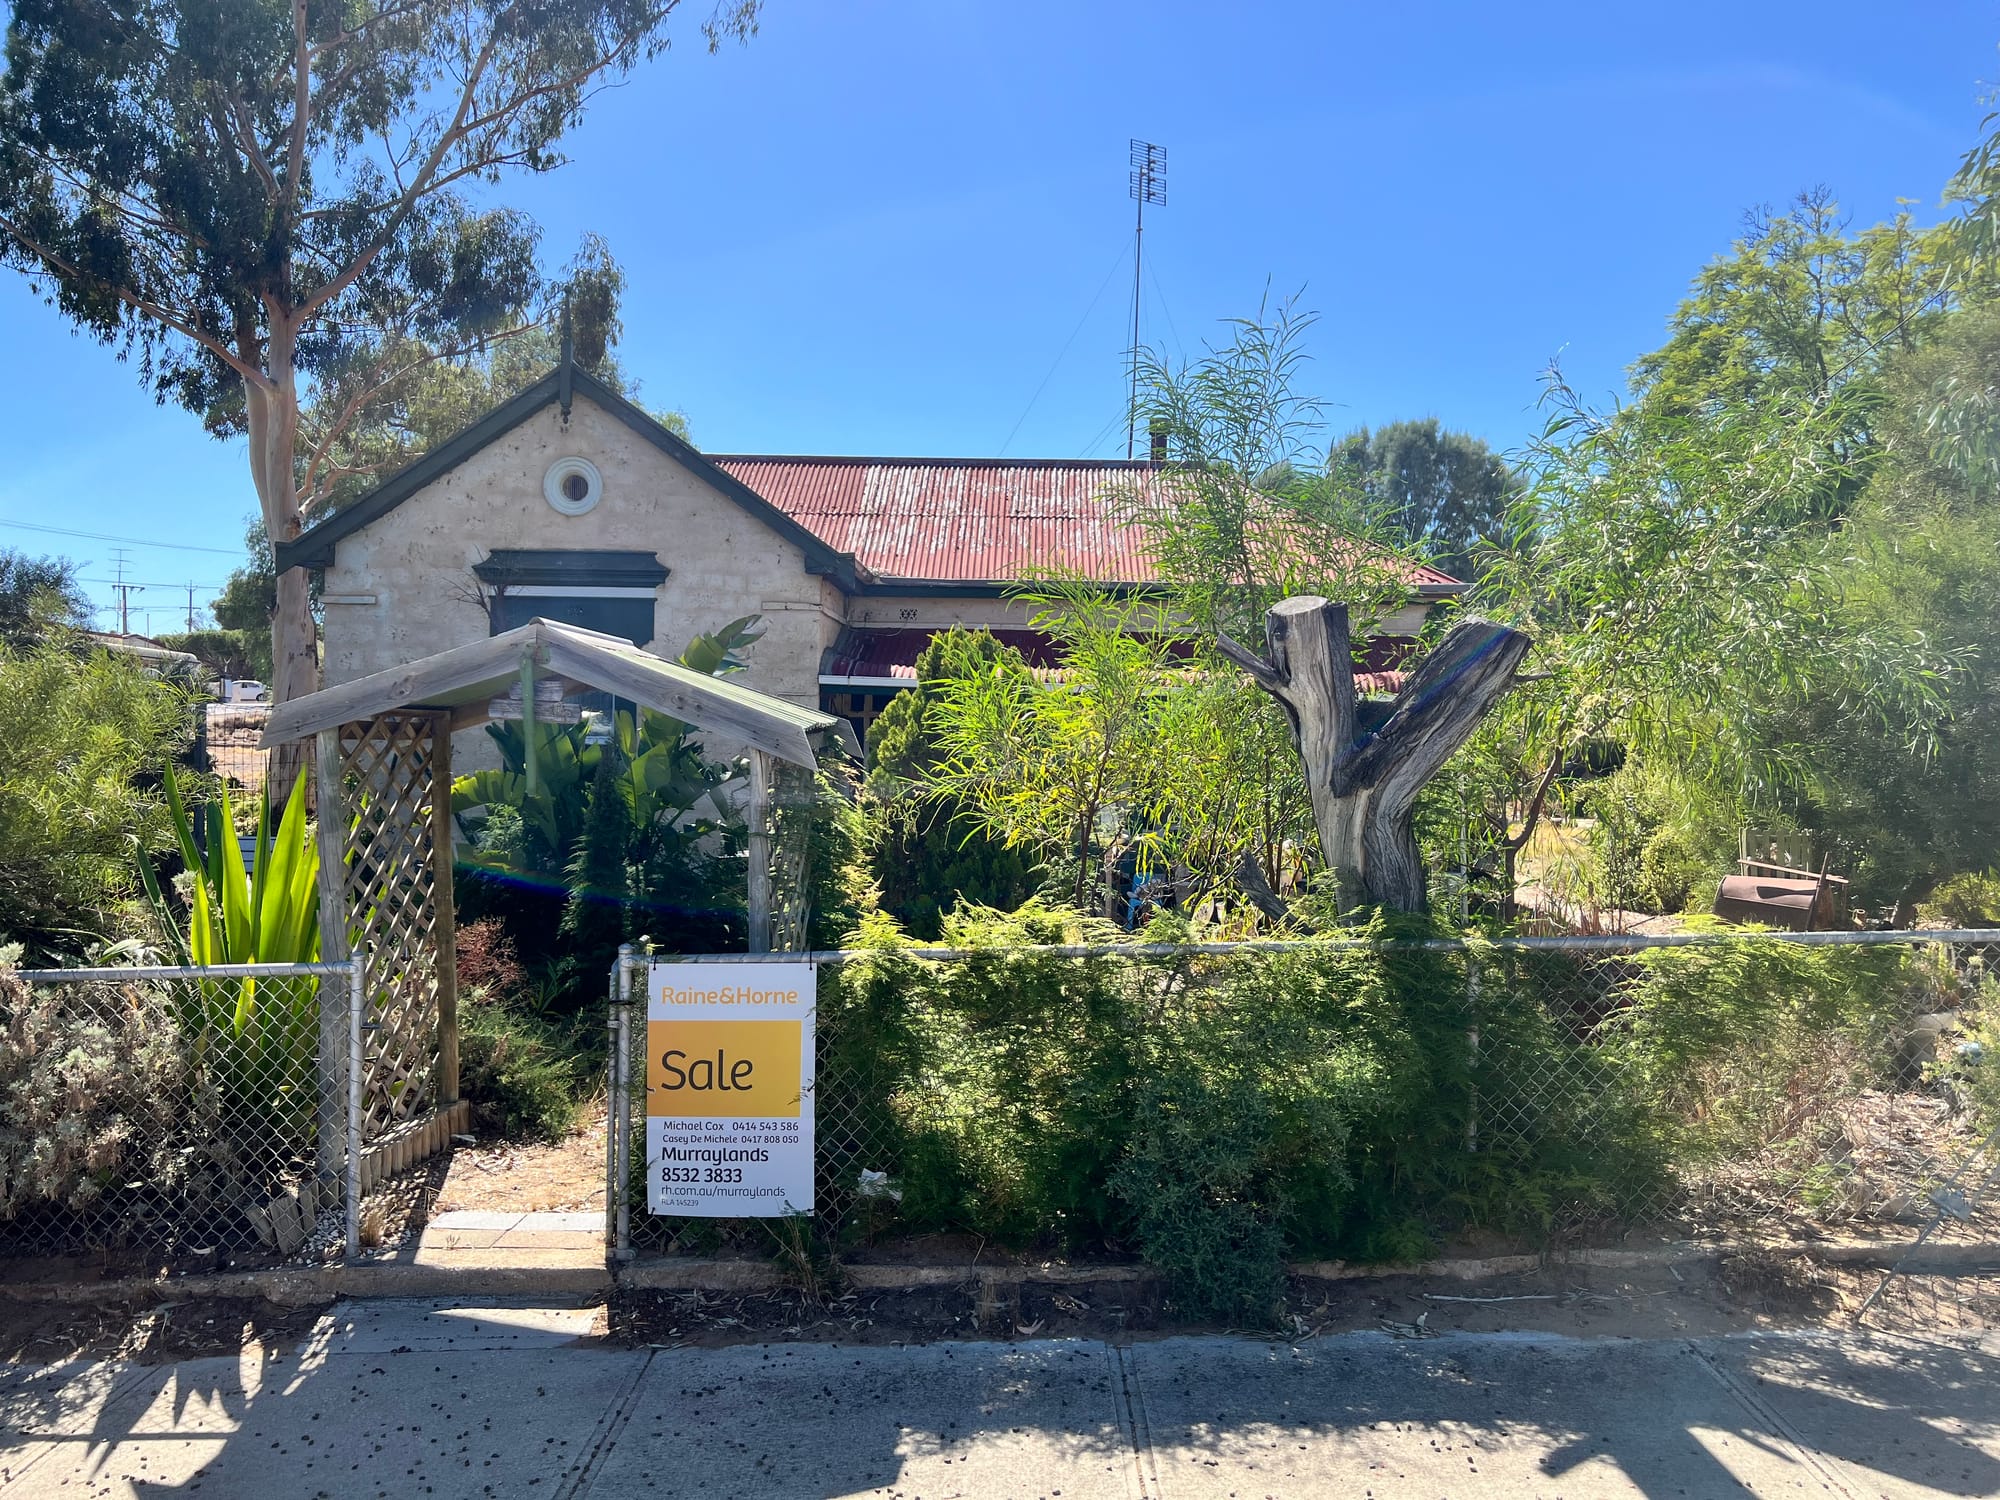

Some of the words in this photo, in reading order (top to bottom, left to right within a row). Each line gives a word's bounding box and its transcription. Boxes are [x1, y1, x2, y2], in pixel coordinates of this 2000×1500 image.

[661, 986, 798, 1005] Raine&Horne
[661, 1049, 753, 1091] Sale
[663, 1121, 703, 1131] Michael
[705, 1121, 724, 1131] Cox
[732, 1121, 757, 1131] 0414
[759, 1121, 778, 1131] 543
[780, 1121, 799, 1131] 586
[662, 1134, 689, 1145] Casey
[690, 1134, 703, 1143] De
[704, 1135, 738, 1144] Michele
[741, 1135, 762, 1144] 0417
[763, 1135, 781, 1144] 808
[782, 1135, 799, 1144] 050
[661, 1147, 769, 1166] Murraylands
[661, 1167, 700, 1183] 8532
[704, 1168, 743, 1183] 3833
[661, 1184, 786, 1199] rh.com.au/murraylands
